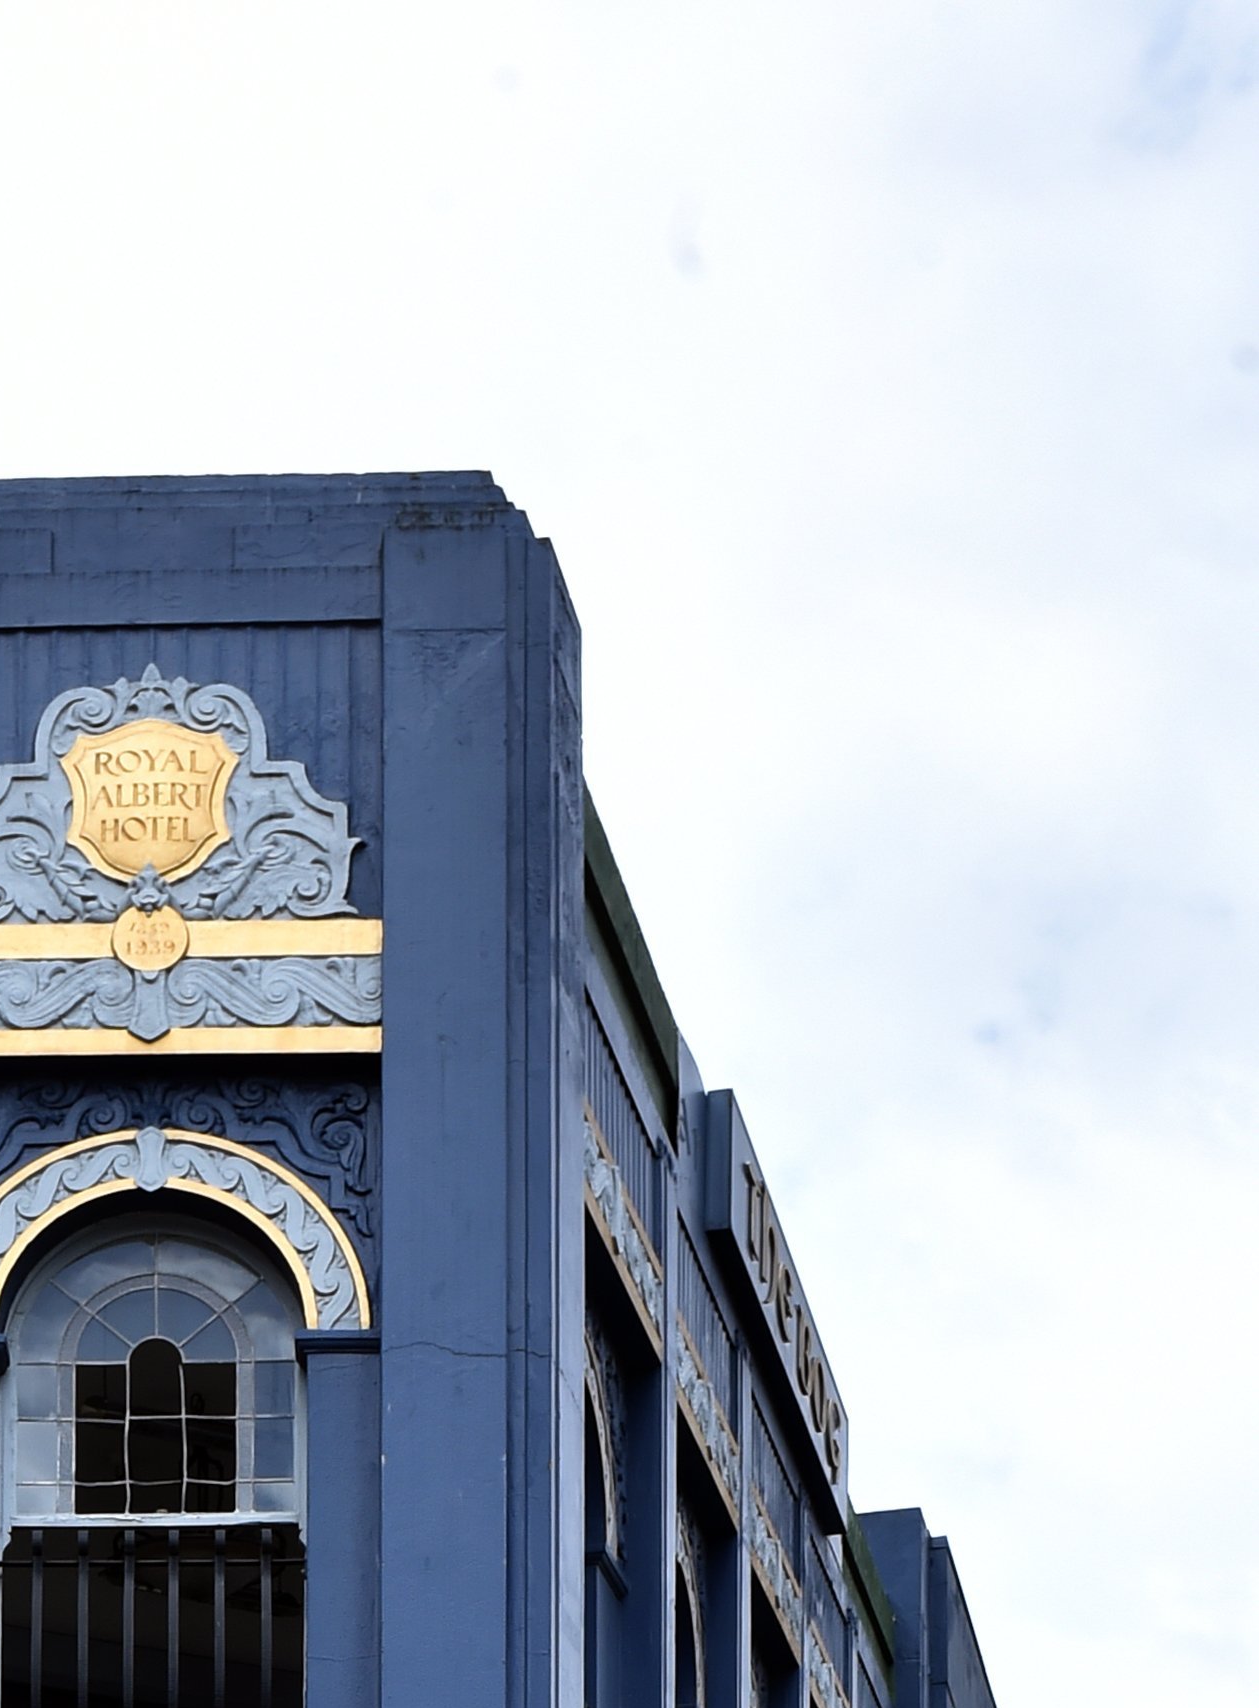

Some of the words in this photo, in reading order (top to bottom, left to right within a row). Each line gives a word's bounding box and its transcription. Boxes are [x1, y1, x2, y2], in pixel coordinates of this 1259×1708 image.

[93, 749, 208, 776] ROYAL
[90, 782, 210, 810] ALBERT
[100, 816, 198, 844] HOTEL
